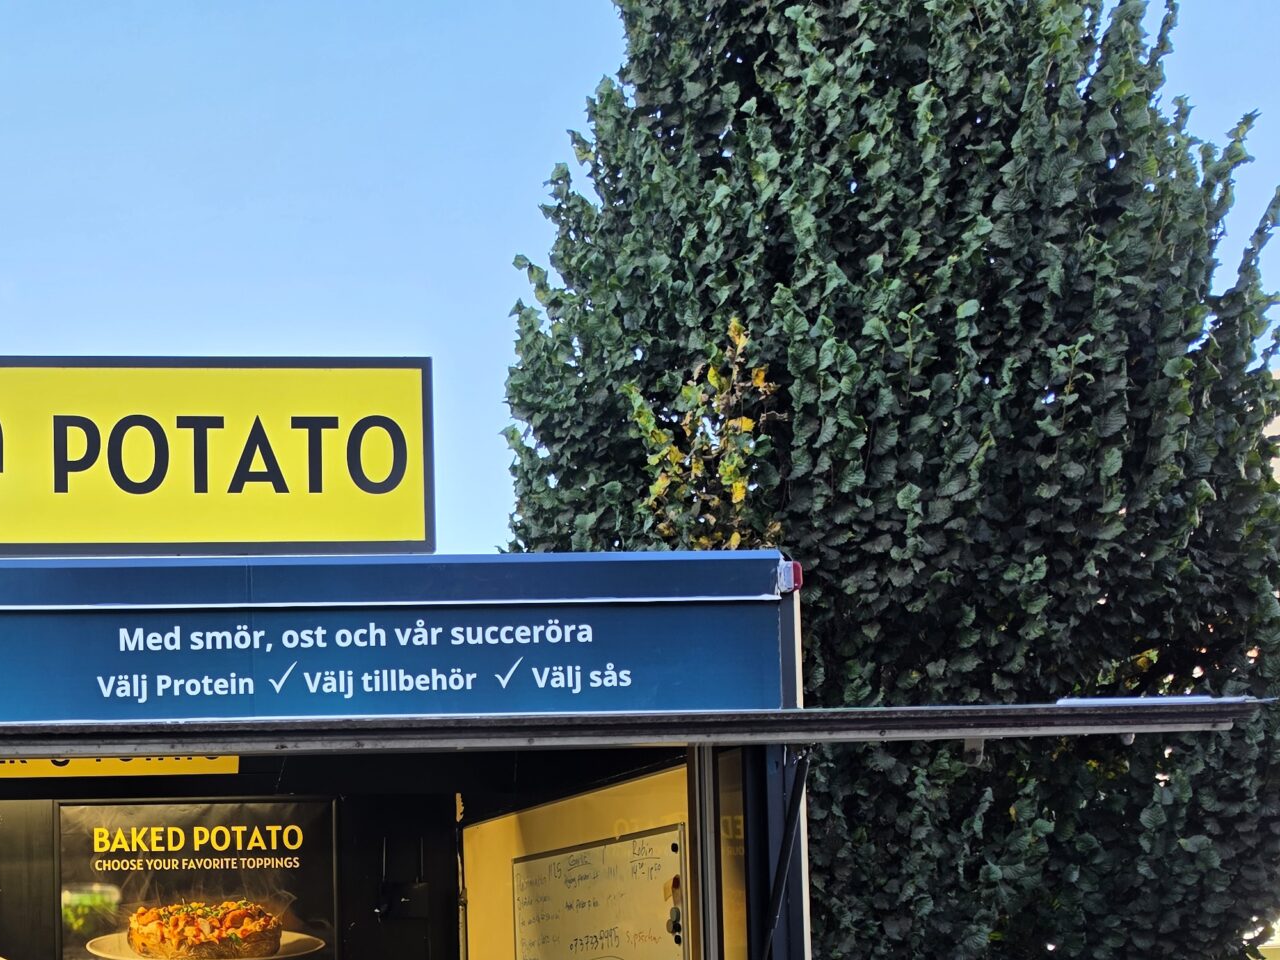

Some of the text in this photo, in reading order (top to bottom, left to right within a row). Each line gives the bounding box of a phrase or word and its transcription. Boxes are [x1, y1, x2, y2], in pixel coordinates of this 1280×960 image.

[53, 414, 409, 494] POTATO
[119, 618, 593, 653] Med smör, ost och vår succeröra
[97, 672, 255, 703] Välj Protein
[304, 667, 477, 700] Välj tillbehör
[532, 662, 632, 693] Välj sås
[93, 825, 304, 853] BAKED POTATO
[95, 857, 300, 871] CHOOSE YOUR FAVORITE TOPPINGS
